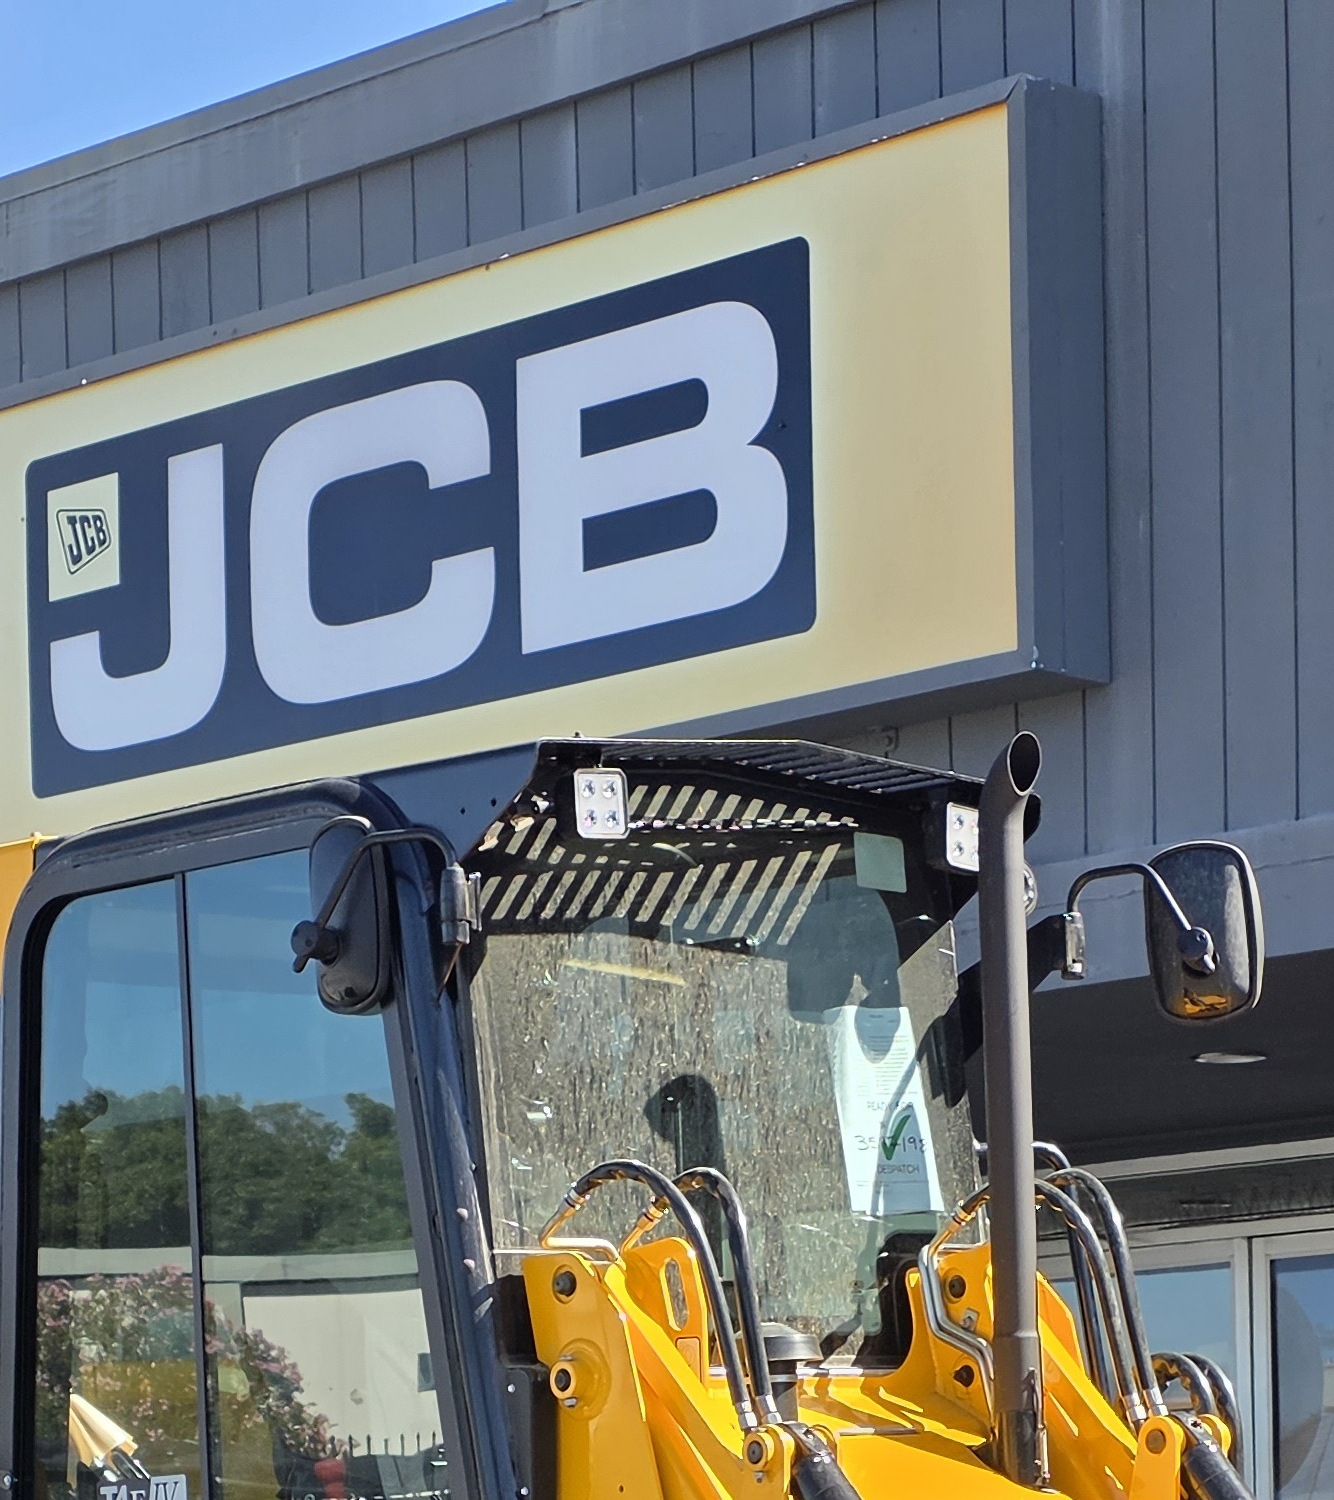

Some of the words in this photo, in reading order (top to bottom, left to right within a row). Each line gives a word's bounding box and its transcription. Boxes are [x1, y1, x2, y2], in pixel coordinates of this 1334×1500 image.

[50, 301, 788, 752] JCB
[66, 514, 108, 567] JCB
[877, 1164, 920, 1174] DESPATCH
